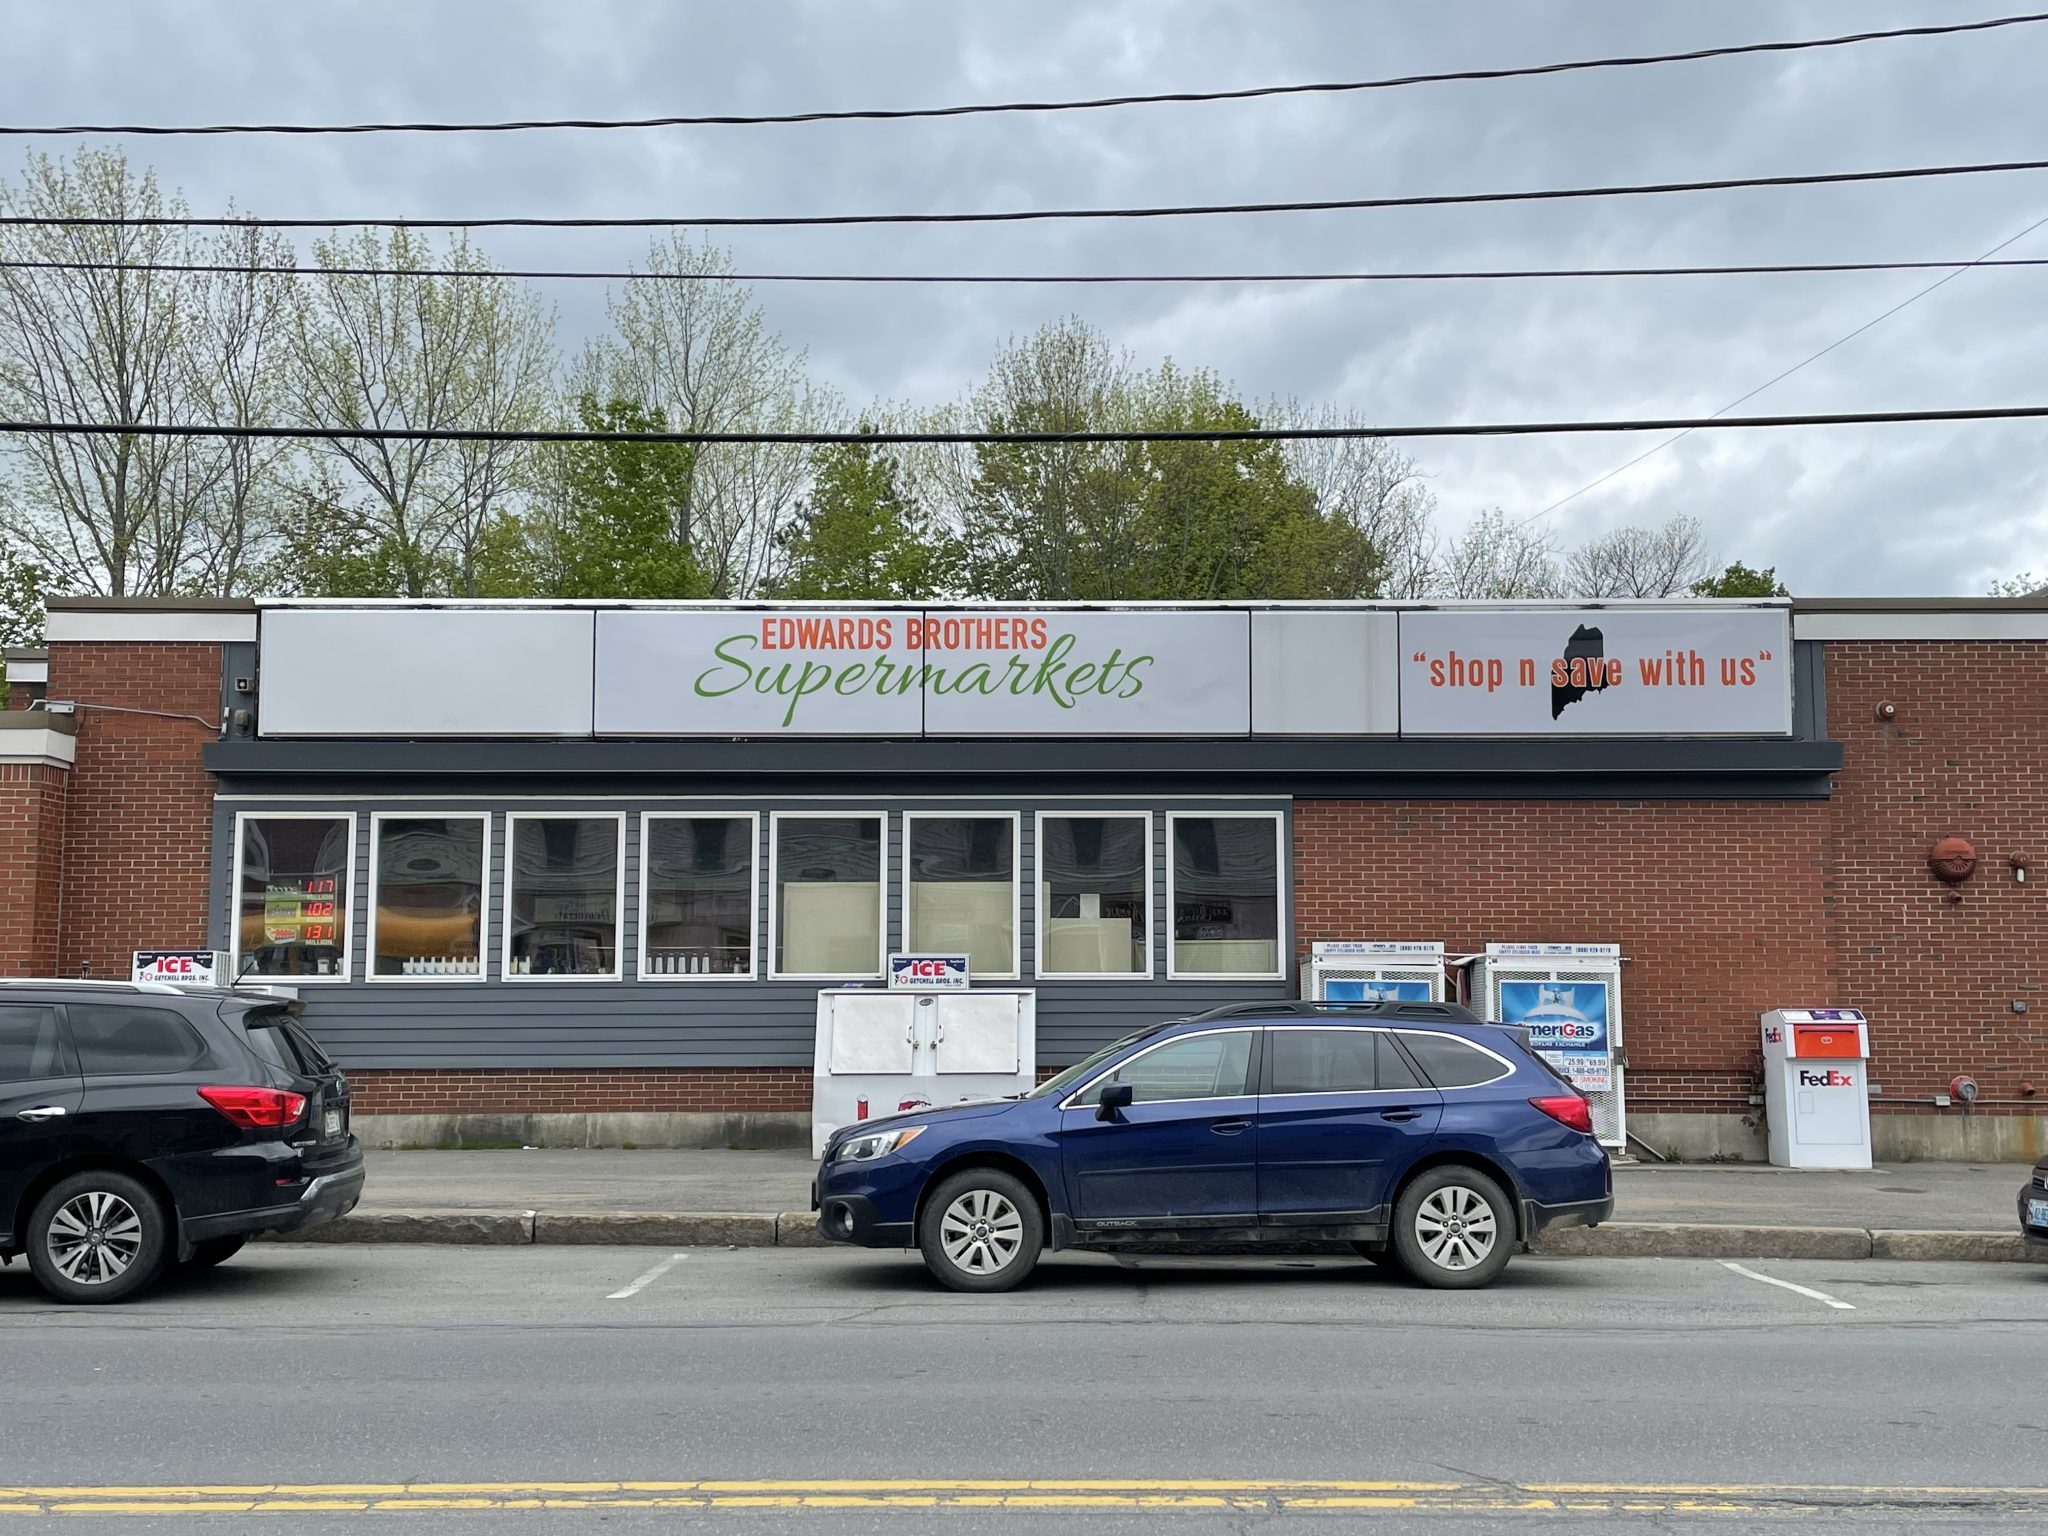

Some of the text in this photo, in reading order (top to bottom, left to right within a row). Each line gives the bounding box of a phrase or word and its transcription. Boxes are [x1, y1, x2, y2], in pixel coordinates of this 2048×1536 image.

[761, 618, 1048, 650] EDWARDS BROTHERS
[1520, 657, 1535, 686] n
[1551, 657, 1623, 688] save
[1639, 649, 1705, 686] with
[693, 633, 1154, 728] Supermarkets
[157, 957, 193, 973] ICE
[912, 960, 946, 976] ICE
[1520, 1023, 1595, 1037] meriGas
[1765, 1027, 1782, 1044] FedEx
[1800, 1070, 1853, 1086] FedEx
